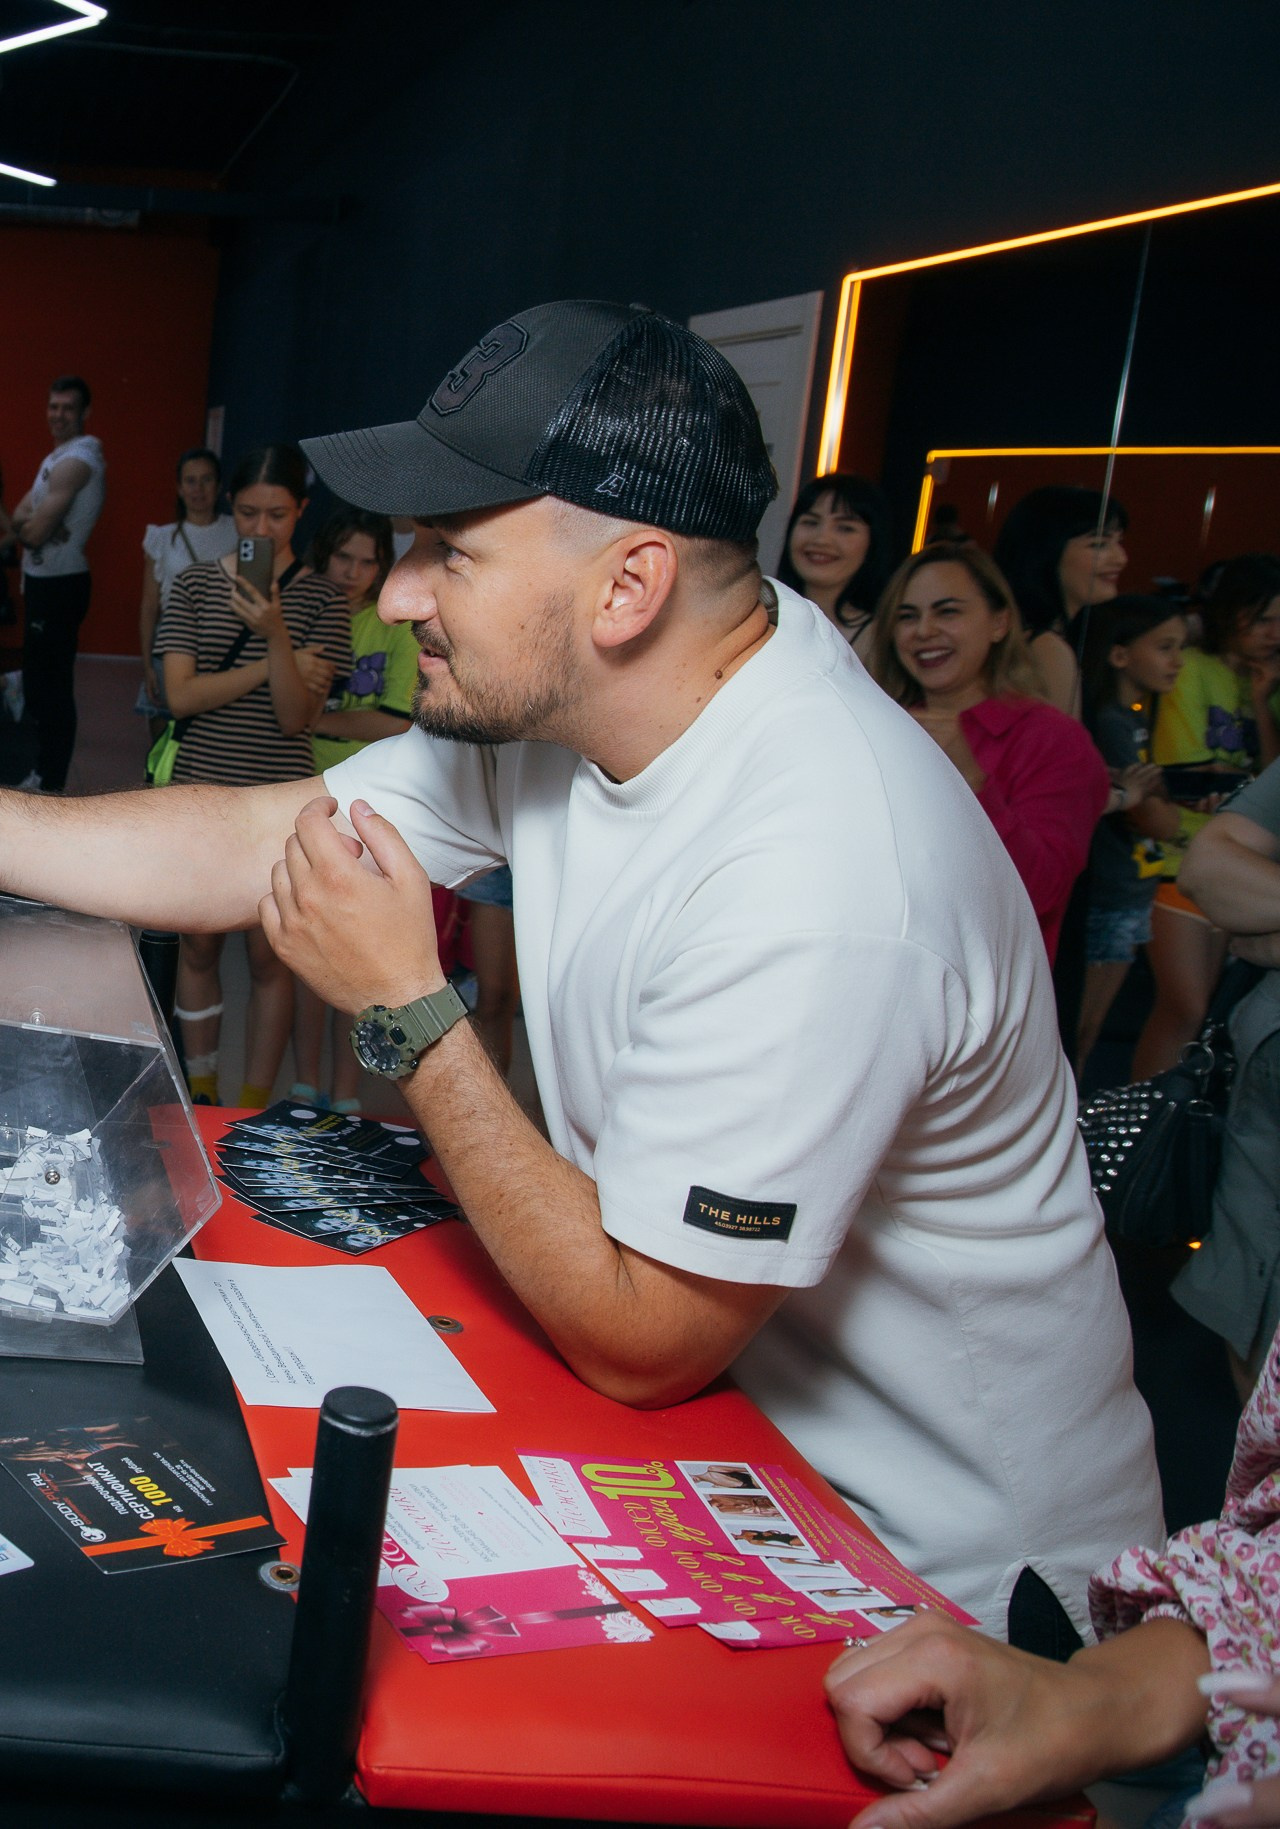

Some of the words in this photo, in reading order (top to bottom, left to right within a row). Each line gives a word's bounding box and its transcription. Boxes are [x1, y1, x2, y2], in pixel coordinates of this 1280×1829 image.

[429, 320, 529, 417] 3
[698, 1202, 731, 1221] THE
[735, 1214, 781, 1226] HILLS
[120, 1456, 146, 1478] рублей
[580, 1460, 688, 1501] 10%
[26, 1473, 85, 1527] BODY-PIT.RU
[82, 1474, 129, 1515] ПОДАРОЧНЫЙ
[87, 1461, 154, 1520] СЕРТИФИКАТ
[129, 1475, 174, 1508] 1000
[539, 1459, 593, 1535] Неженка
